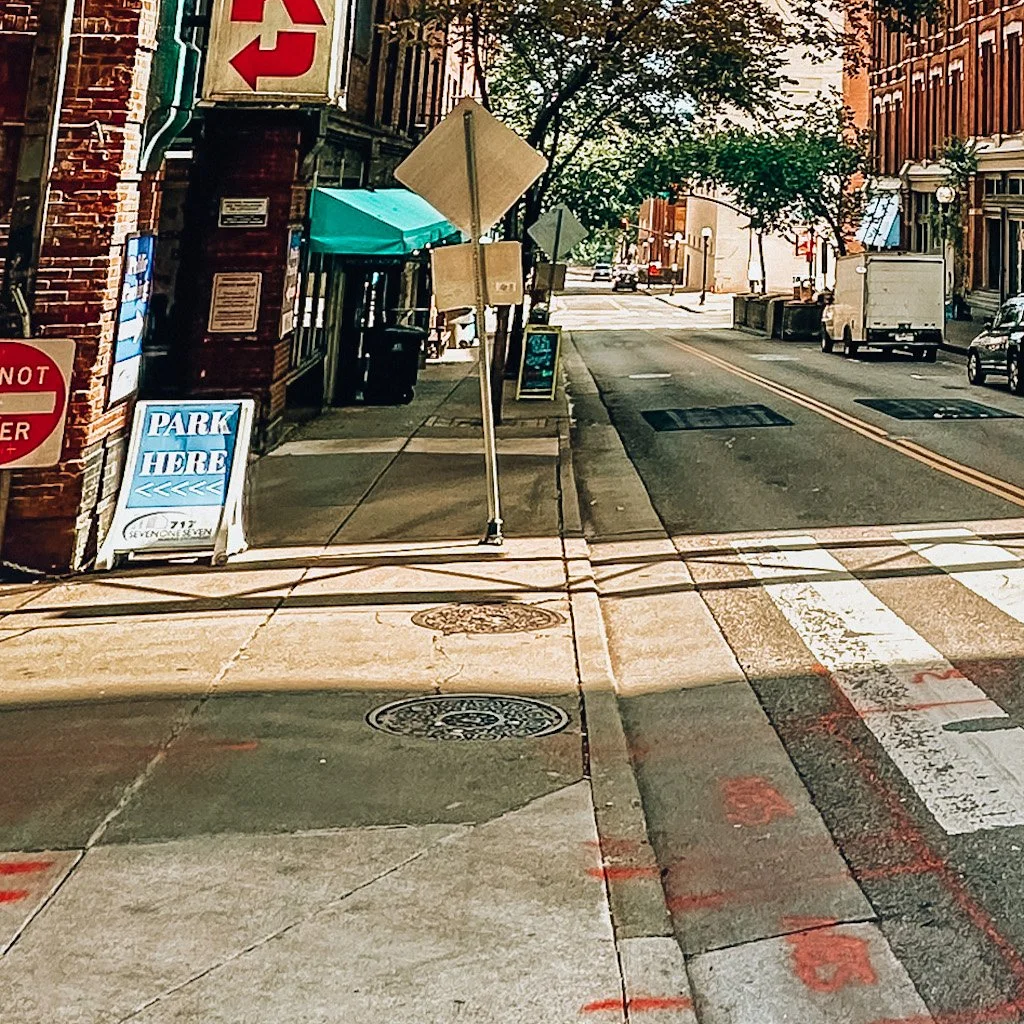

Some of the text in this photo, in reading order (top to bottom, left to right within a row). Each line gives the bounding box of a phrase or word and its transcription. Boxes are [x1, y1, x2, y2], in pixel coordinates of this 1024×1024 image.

[0, 365, 50, 386] NOT
[146, 410, 234, 437] PARK
[138, 450, 228, 477] HERE
